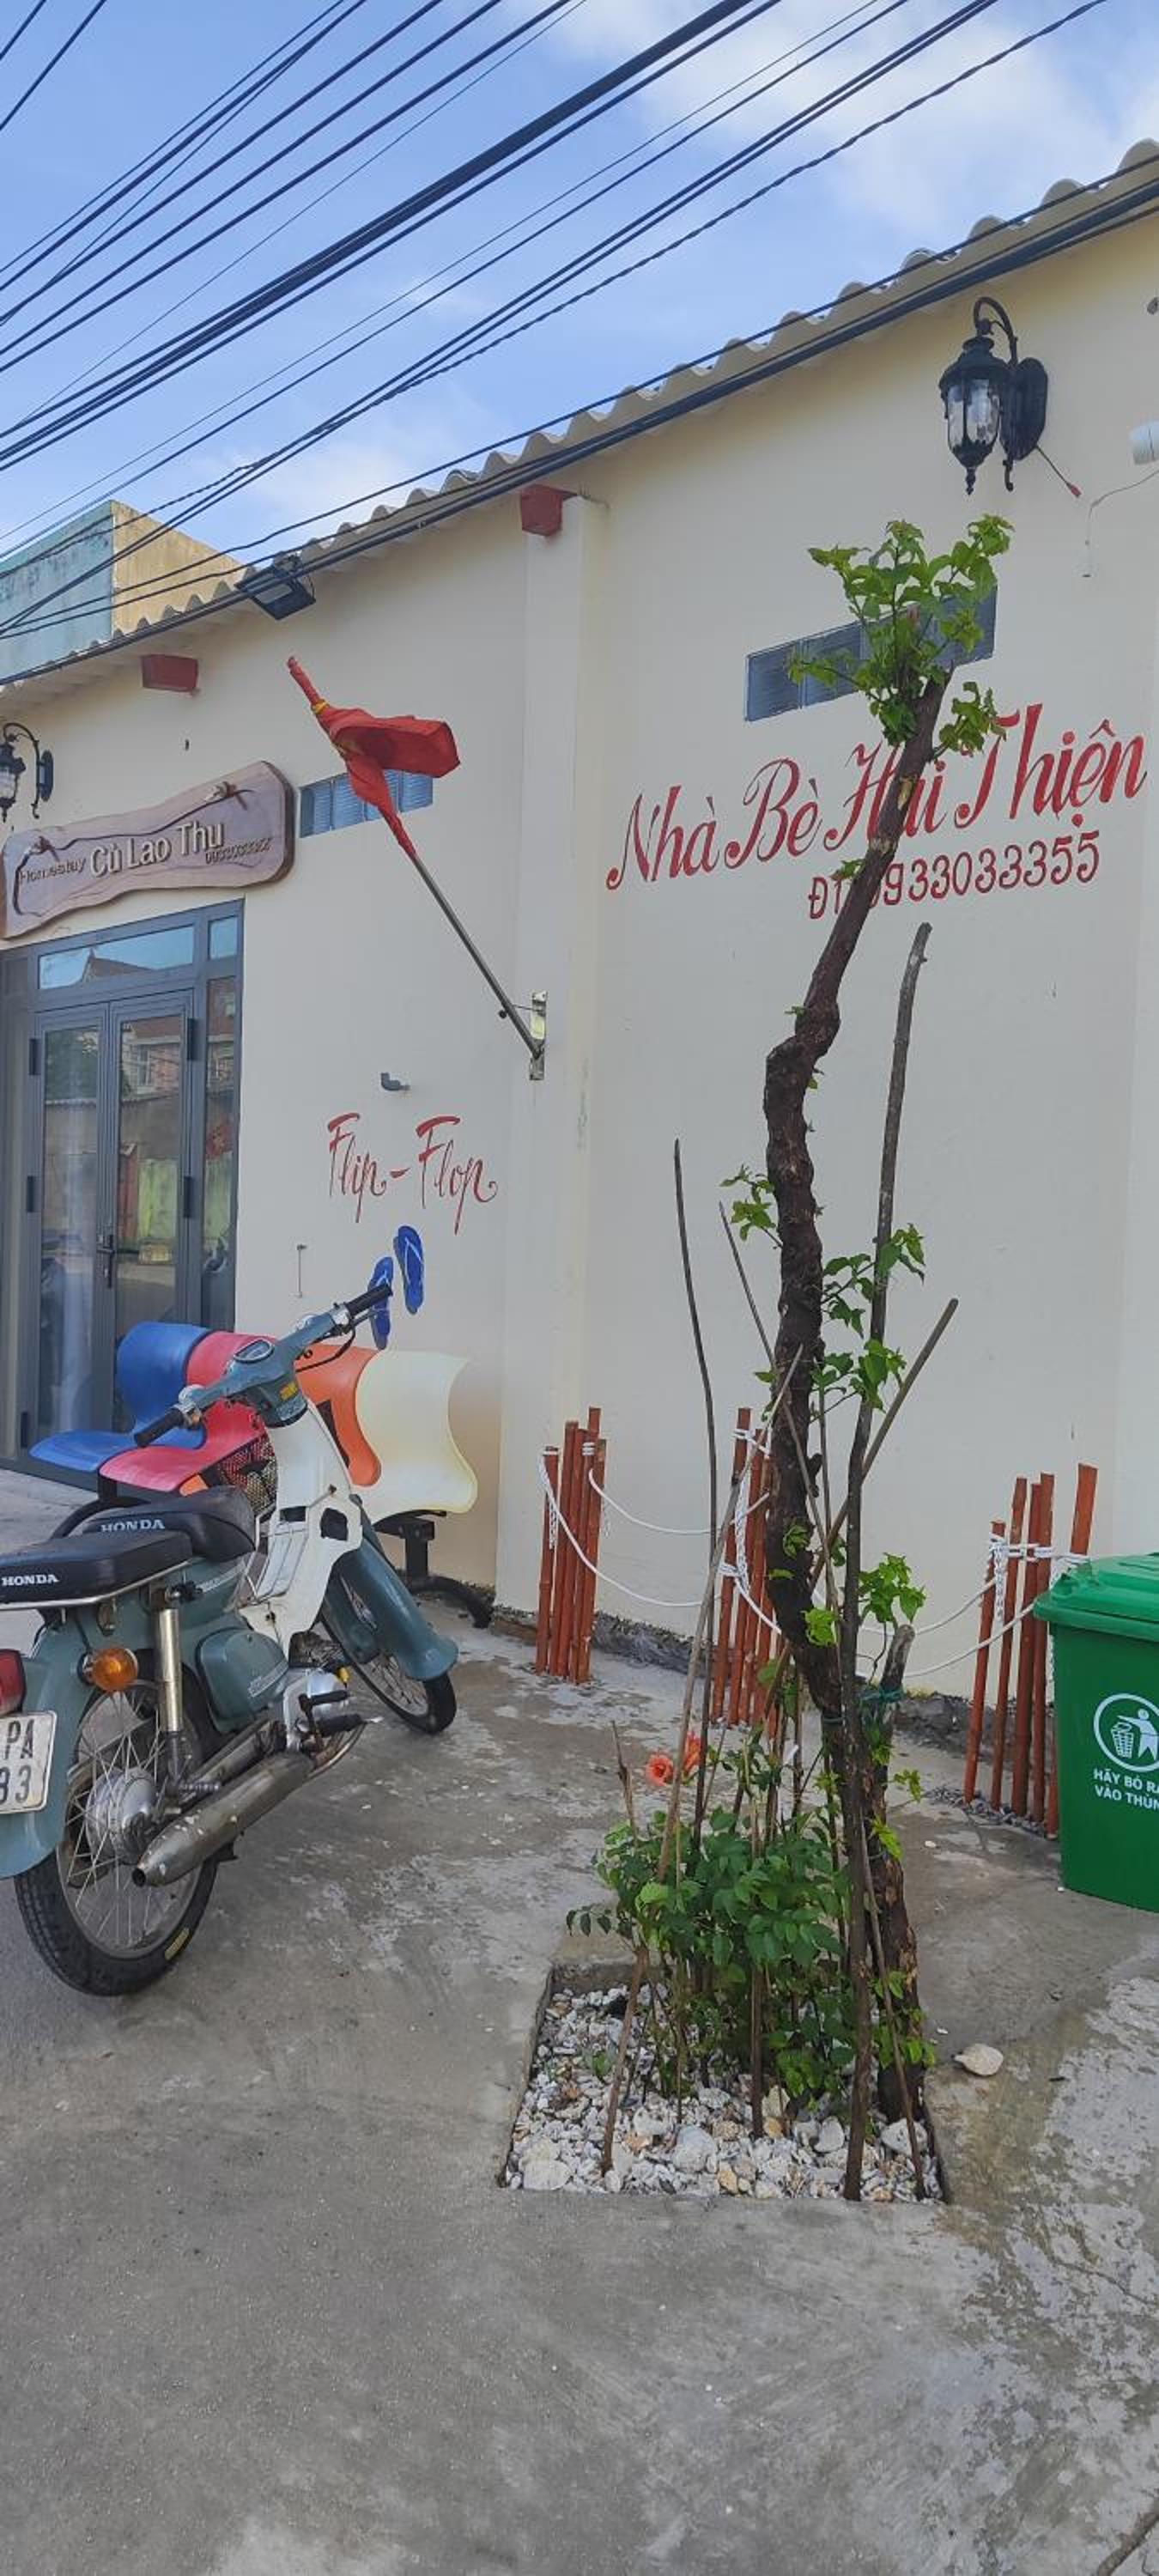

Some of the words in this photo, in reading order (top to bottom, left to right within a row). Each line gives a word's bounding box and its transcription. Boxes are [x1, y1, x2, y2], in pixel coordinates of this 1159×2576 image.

[605, 785, 721, 890] Nhà
[724, 757, 823, 869] Bè
[955, 703, 1148, 829] Thiện
[128, 836, 172, 871] Lao
[177, 820, 225, 856] Thu
[870, 829, 1101, 910] 933033355
[100, 1518, 166, 1533] HONDA
[1, 1573, 60, 1587] HONDA
[1093, 1767, 1120, 1784] HÃY
[1094, 1783, 1122, 1801] VÀO
